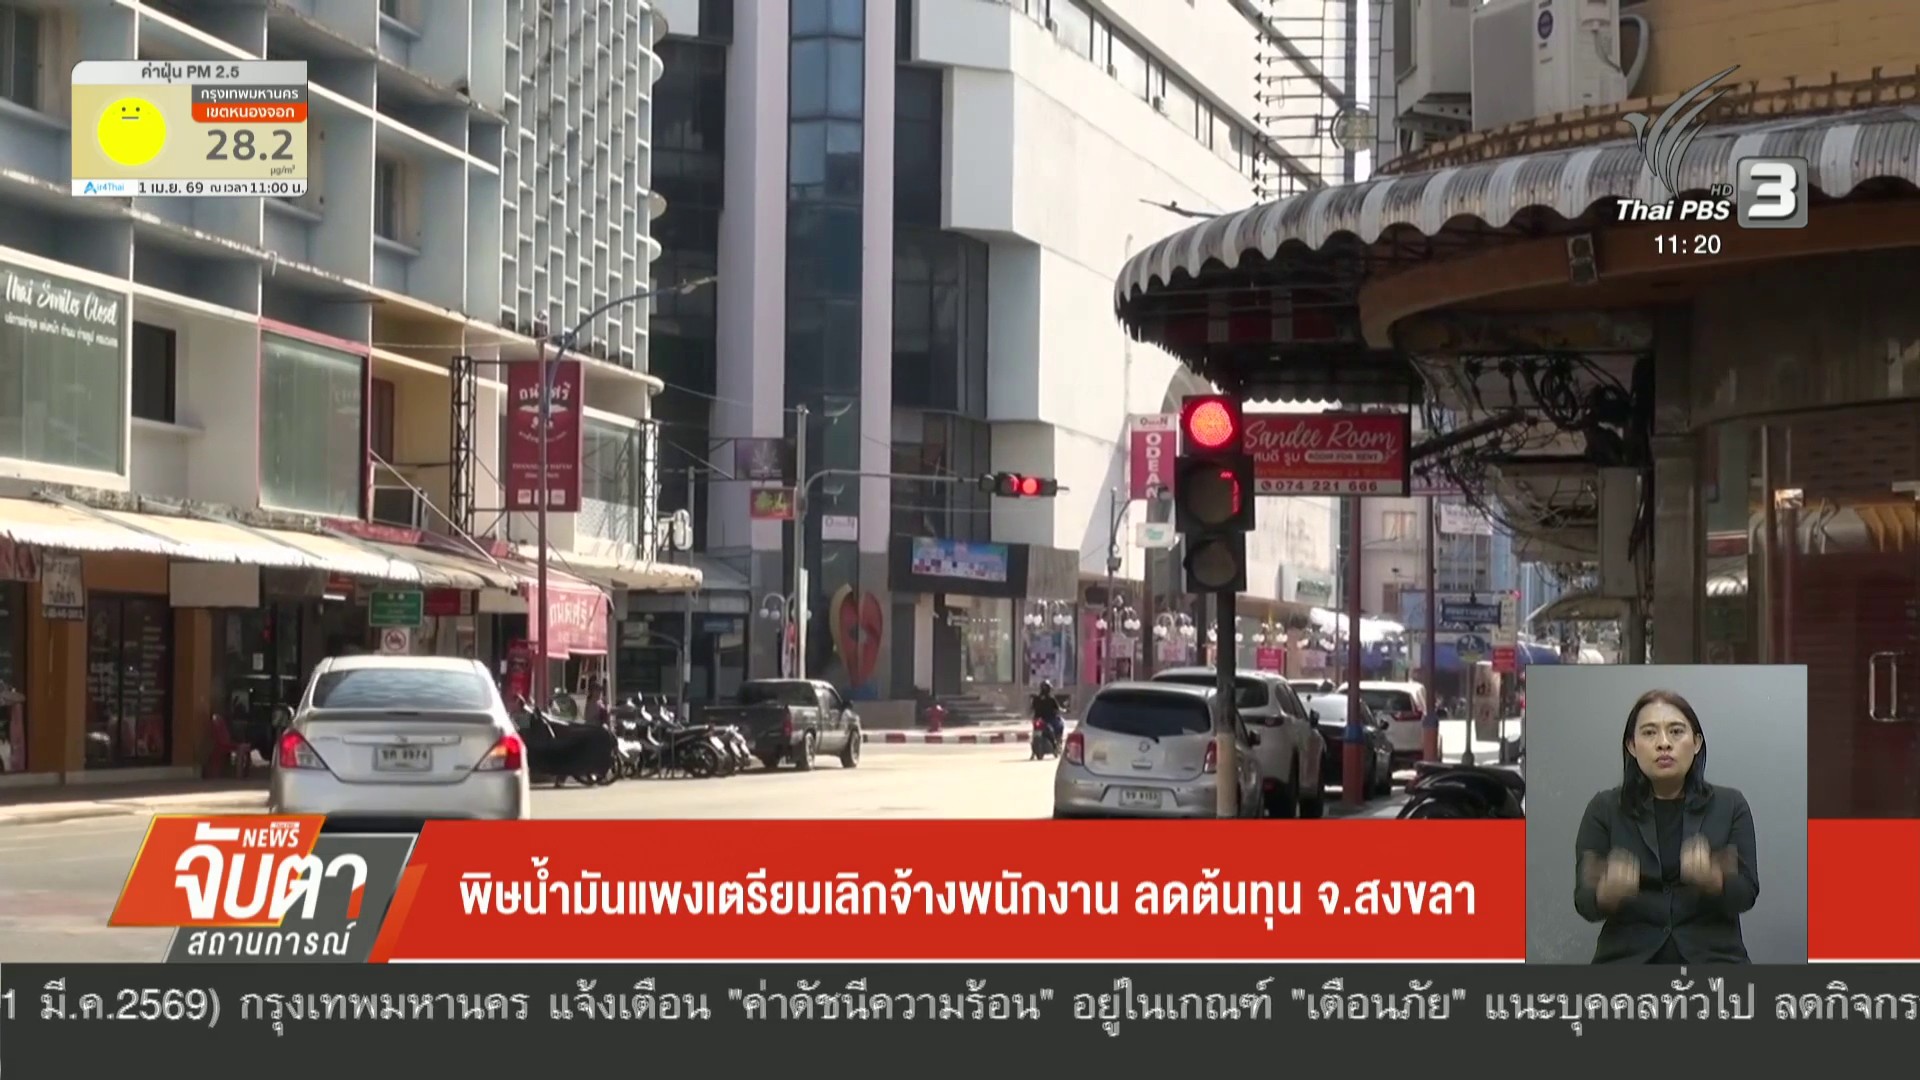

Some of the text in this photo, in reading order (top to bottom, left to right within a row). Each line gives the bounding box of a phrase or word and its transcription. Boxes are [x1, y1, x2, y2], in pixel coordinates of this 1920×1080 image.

[4, 270, 34, 306] Thai
[1245, 420, 1396, 450] Sandee Room
[1145, 432, 1162, 499] ODEAN
[1275, 481, 1304, 492] 074
[1312, 481, 1340, 492] 221
